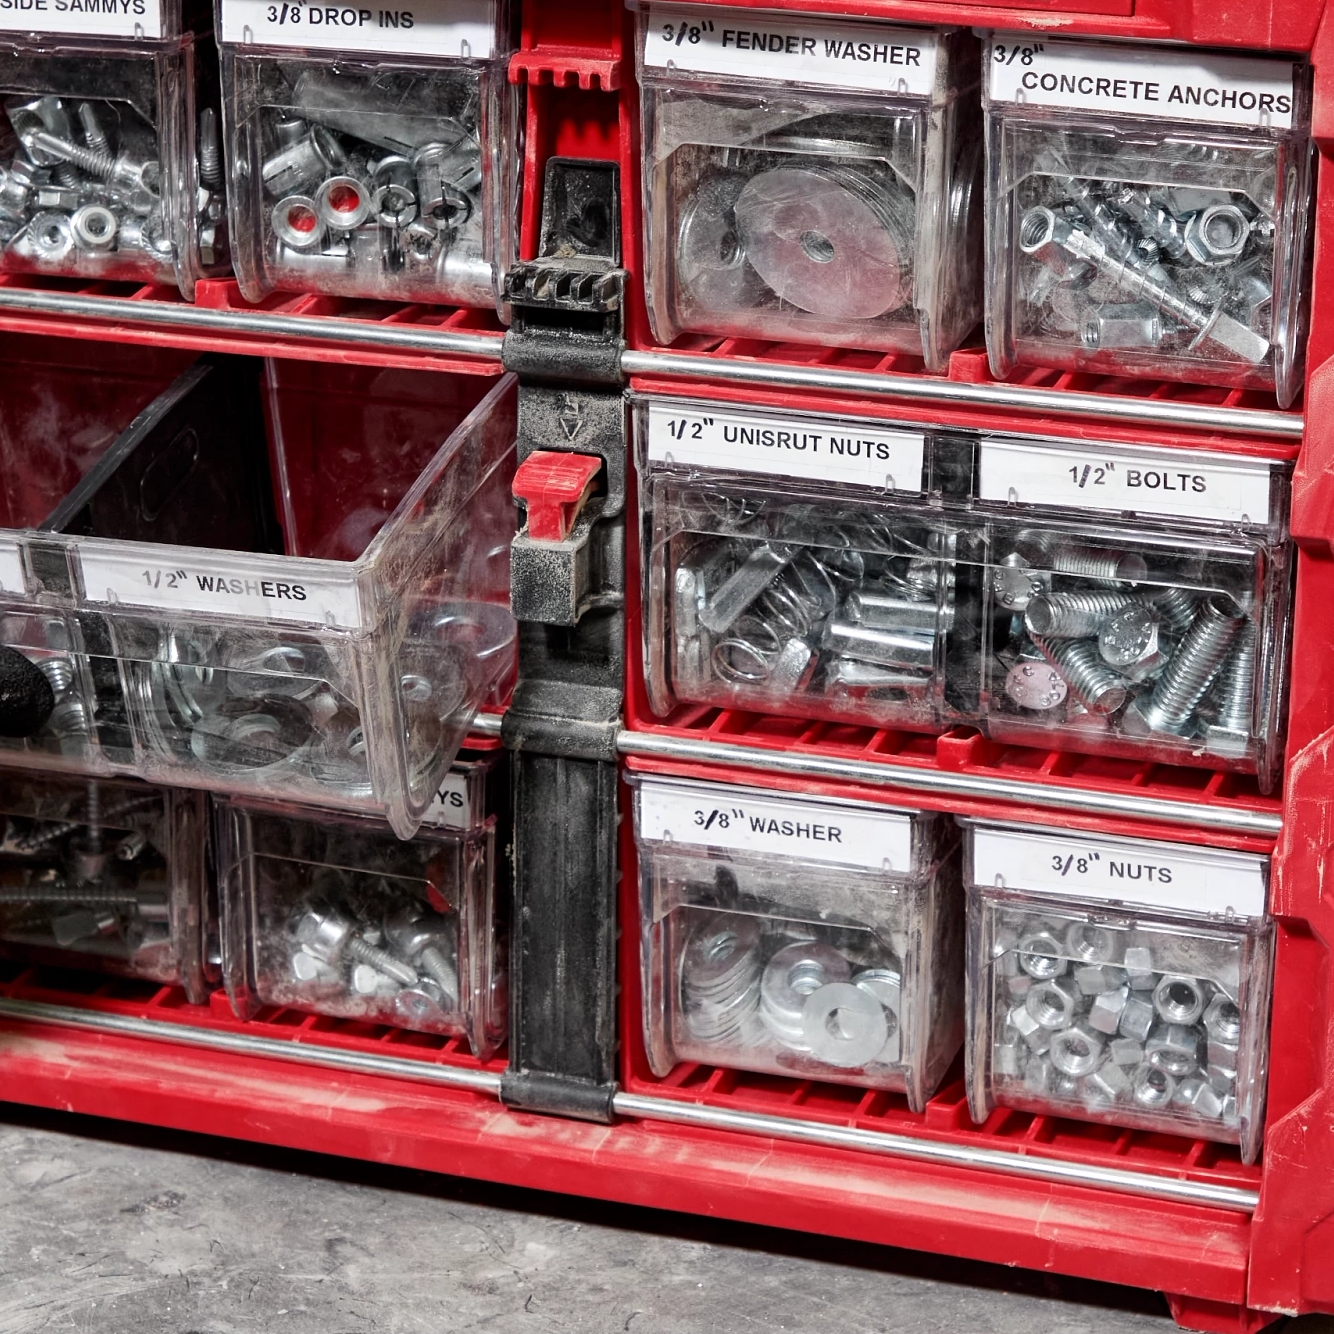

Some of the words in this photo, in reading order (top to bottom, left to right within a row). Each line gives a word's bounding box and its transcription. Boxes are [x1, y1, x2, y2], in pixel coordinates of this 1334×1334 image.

[308, 7, 373, 27] DROP
[378, 10, 415, 29] INS
[661, 20, 715, 47] 3/8"
[721, 29, 817, 57] FENDER
[823, 39, 922, 67] WASHER
[993, 44, 1045, 66] 3/8"
[1021, 71, 1160, 103] CONCRETE
[1167, 85, 1292, 114] ANCHORS
[667, 418, 714, 440] 1/2"
[723, 425, 823, 453] UNISRUT
[829, 437, 891, 461] NUTS
[1069, 462, 1115, 488] 1/2"
[1126, 469, 1207, 493] BOLTS
[142, 570, 187, 589] 1/2"
[196, 575, 307, 601] WASHERS
[693, 808, 745, 830] 3/8"
[749, 816, 843, 844] WASHER
[1051, 852, 1100, 877] 3/8"
[1109, 861, 1173, 884] NUTS
